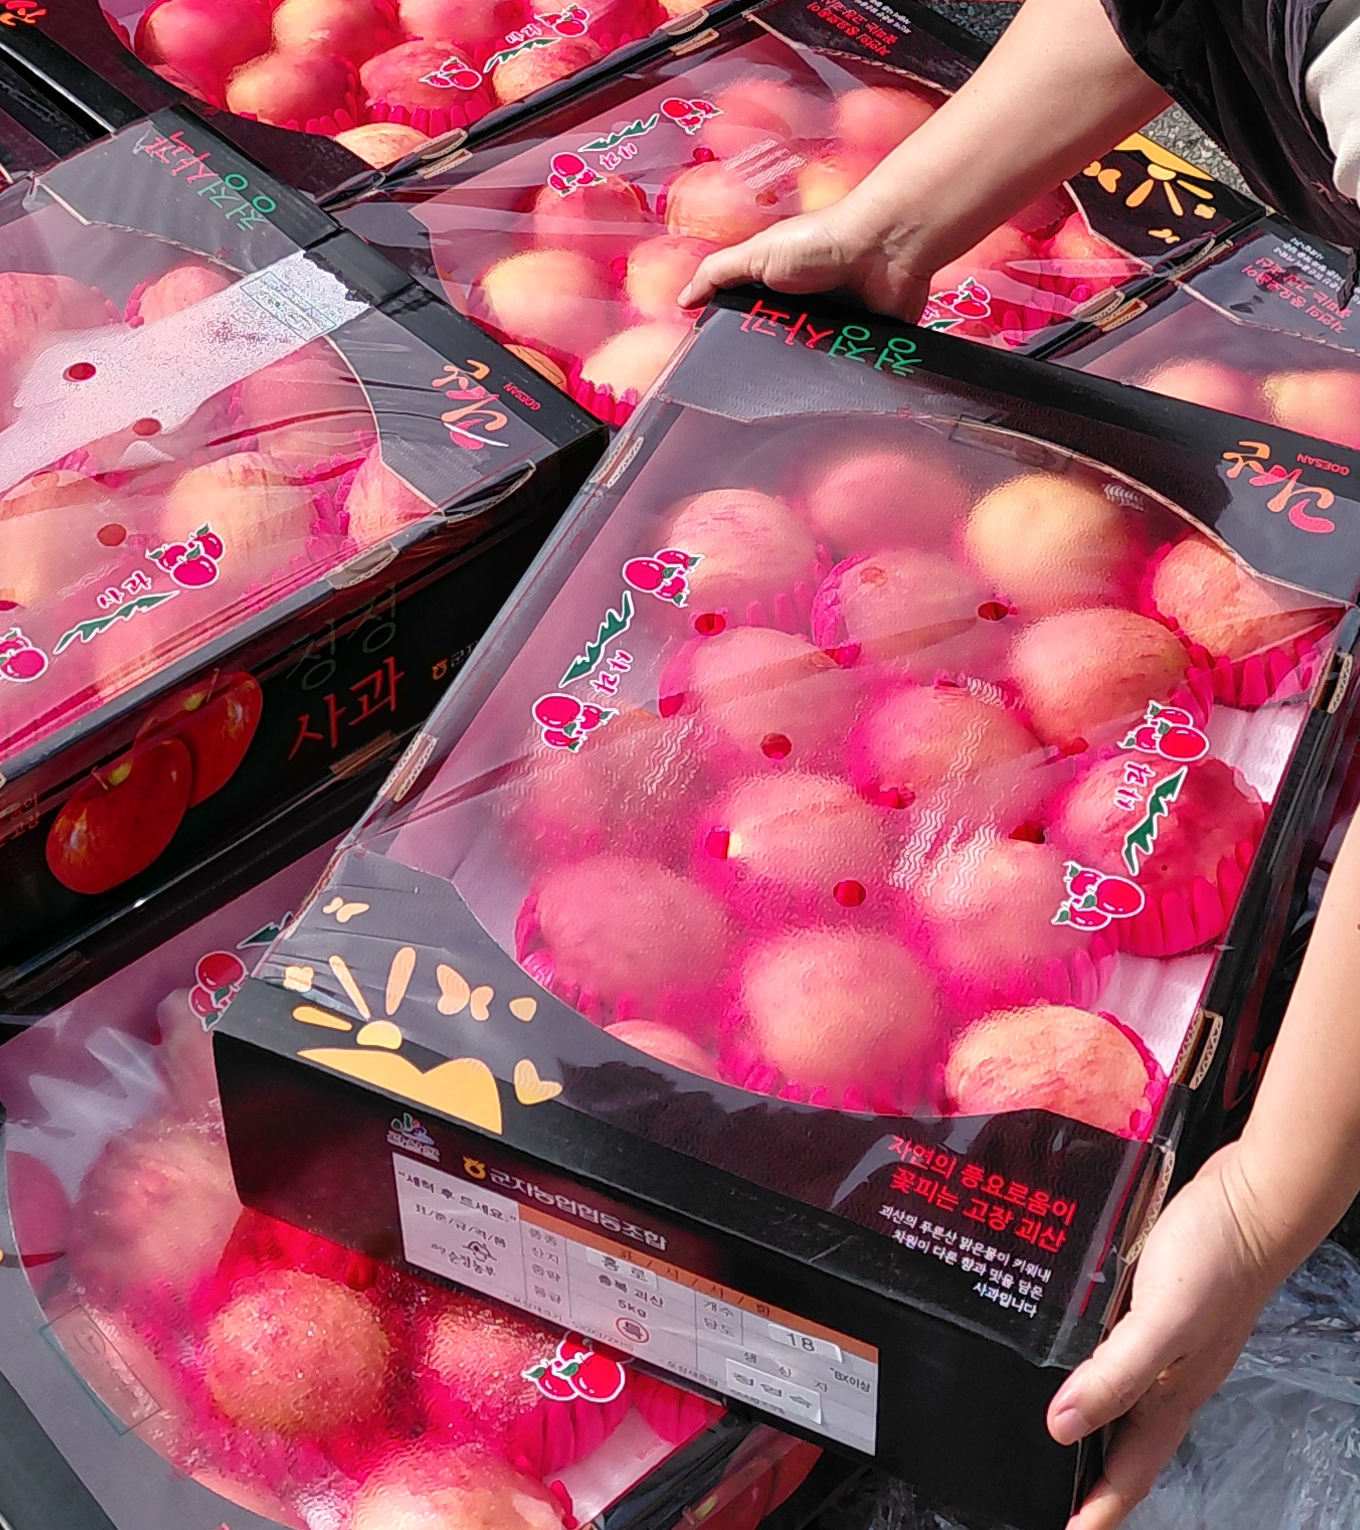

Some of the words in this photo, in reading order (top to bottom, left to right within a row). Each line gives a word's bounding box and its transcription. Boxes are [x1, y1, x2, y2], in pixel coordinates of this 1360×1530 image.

[196, 173, 277, 232] 청정
[738, 299, 835, 350] 사과
[827, 324, 924, 377] 청정
[431, 358, 509, 451] 괴산
[1222, 440, 1336, 534] 괴산
[96, 569, 153, 610] 사과
[286, 654, 407, 763] 사과
[887, 1135, 957, 1180] 자연의
[960, 1163, 1078, 1227] 풍요로움이
[489, 1168, 669, 1253] 군자농업협동조합
[879, 1204, 918, 1230] 괴산의
[919, 1220, 959, 1246] 푸른산
[890, 1167, 959, 1213] 꽃피는
[962, 1197, 1015, 1232] 고장
[1014, 1218, 1068, 1254] 괴산
[892, 1228, 932, 1254] 차원이
[932, 1244, 958, 1266] 다른
[1018, 1280, 1044, 1301] 담은
[617, 1298, 648, 1319] 5kg
[633, 1287, 665, 1310] 괴산
[702, 1298, 735, 1318] 개수
[787, 1332, 816, 1353] 18
[972, 1281, 1038, 1319] 사과입니다
